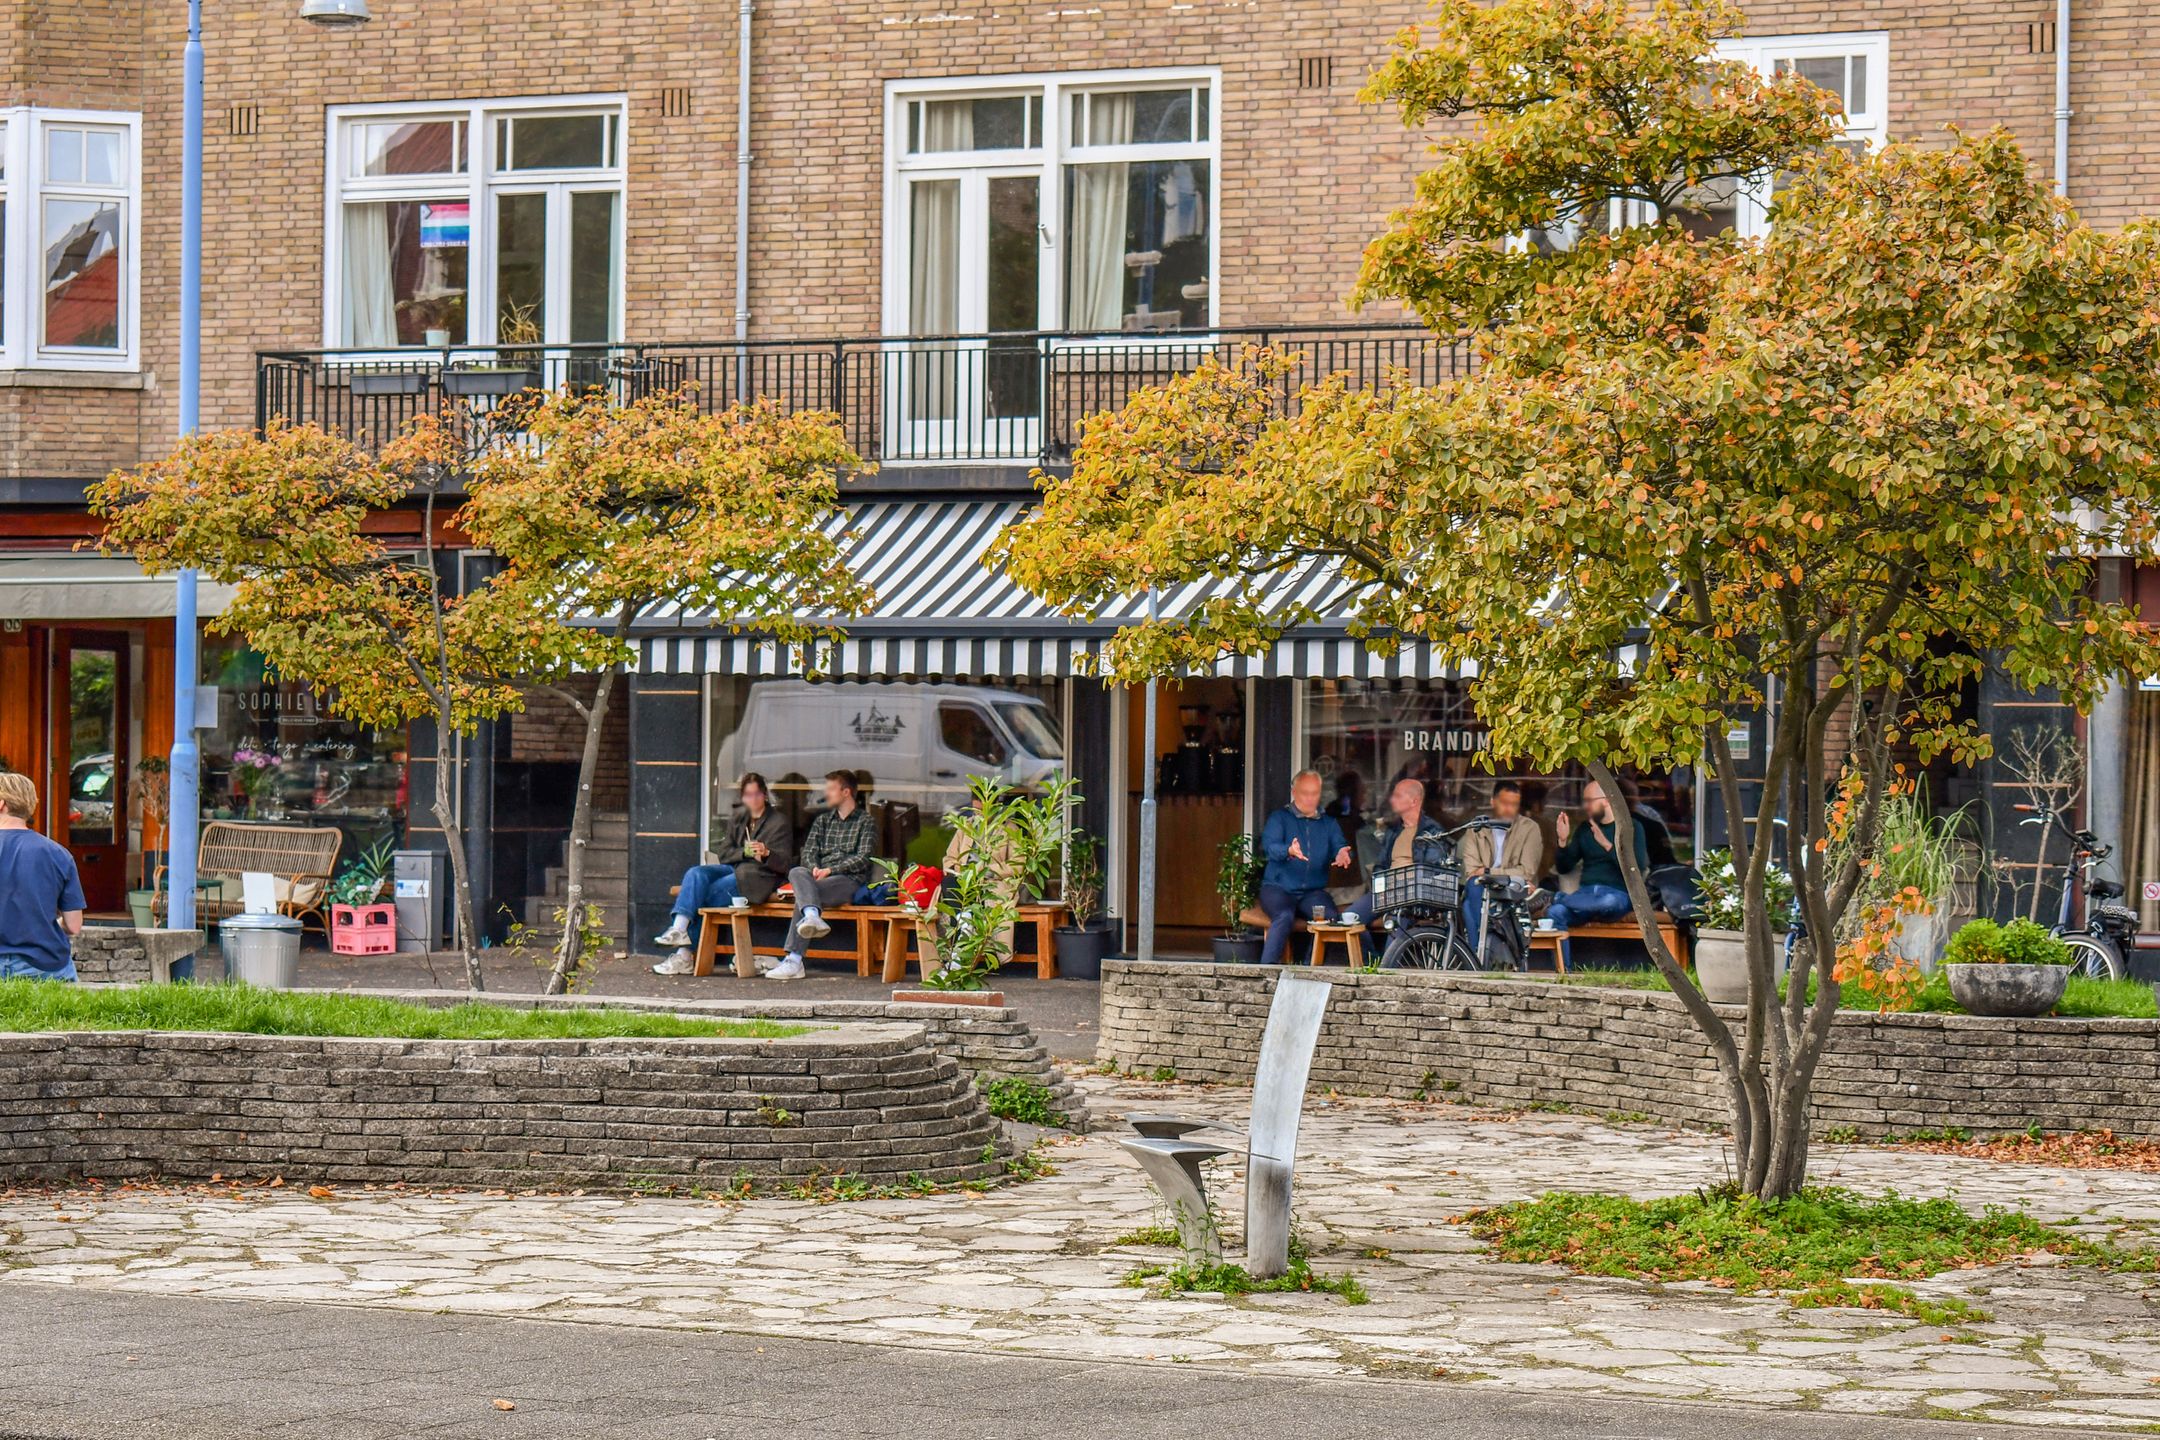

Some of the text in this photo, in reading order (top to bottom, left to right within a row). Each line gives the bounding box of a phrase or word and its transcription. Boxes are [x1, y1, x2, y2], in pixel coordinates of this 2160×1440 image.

[239, 692, 305, 711] SOPHIE
[284, 743, 299, 759] go
[313, 737, 357, 760] catering
[1404, 730, 1491, 751] BRANDM
